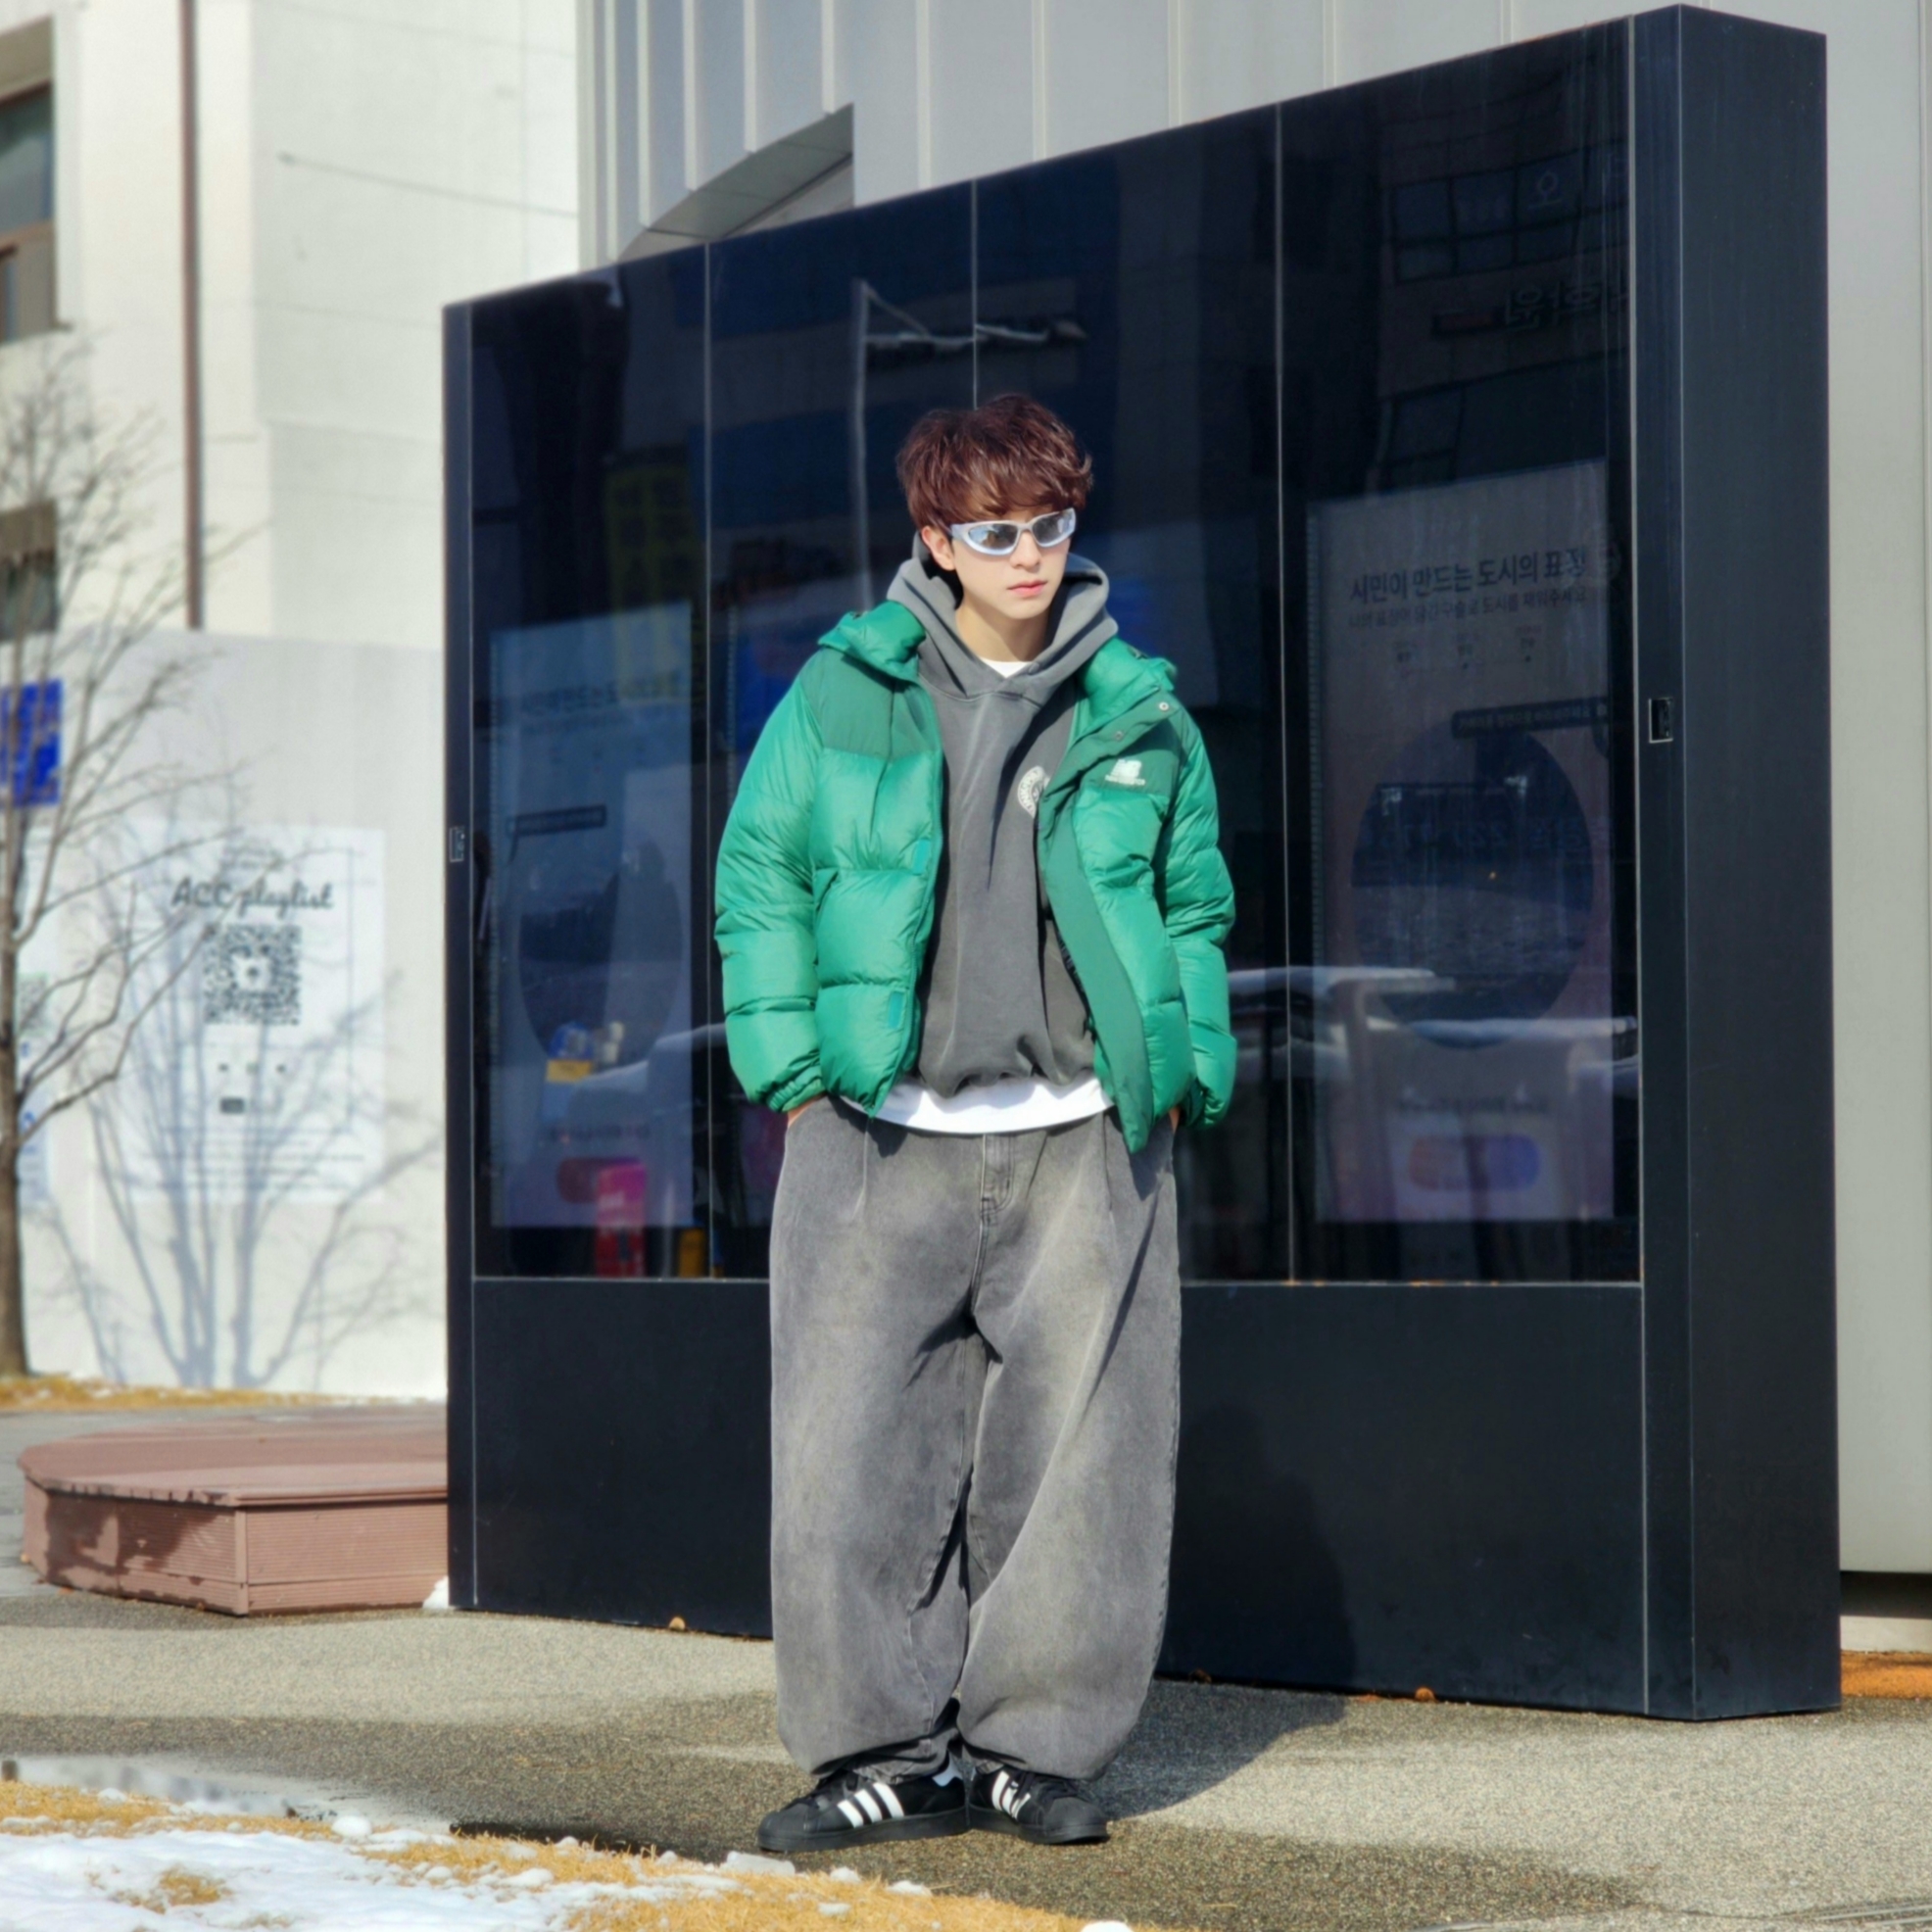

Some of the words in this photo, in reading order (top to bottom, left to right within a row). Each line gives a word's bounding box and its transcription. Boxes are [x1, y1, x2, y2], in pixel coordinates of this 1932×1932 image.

[1349, 570, 1408, 604] 시민이
[1412, 562, 1473, 596] 만드는
[1476, 552, 1538, 588] 도시의
[1544, 548, 1586, 579] 표정
[1481, 594, 1519, 614] 도시를
[1522, 586, 1588, 609] 채워주세요
[170, 876, 233, 909] ACC
[237, 877, 334, 918] playlist
